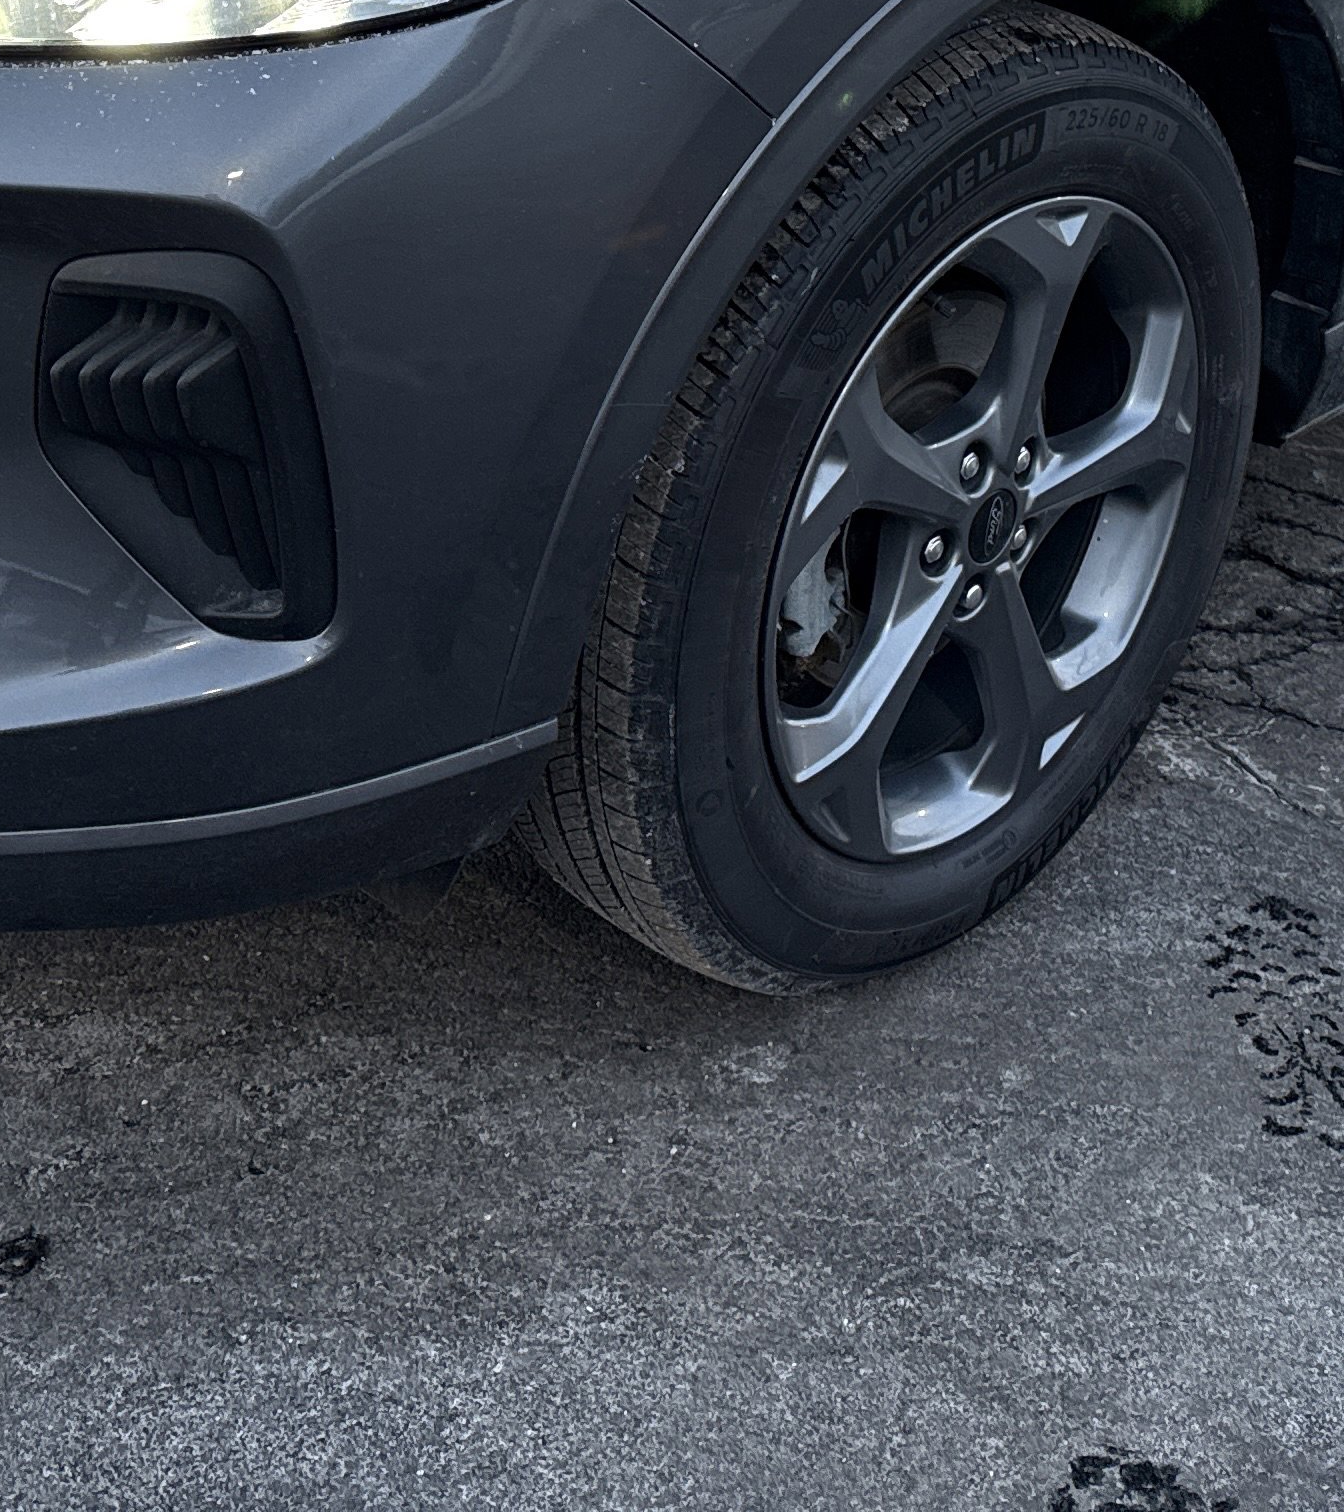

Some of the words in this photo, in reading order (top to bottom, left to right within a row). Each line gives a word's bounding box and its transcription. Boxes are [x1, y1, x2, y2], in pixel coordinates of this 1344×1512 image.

[1065, 108, 1132, 131] 225/60
[1135, 112, 1149, 134] R
[1152, 119, 1169, 142] 18
[860, 123, 1037, 295] MICHELIN
[987, 508, 1003, 545] Ford
